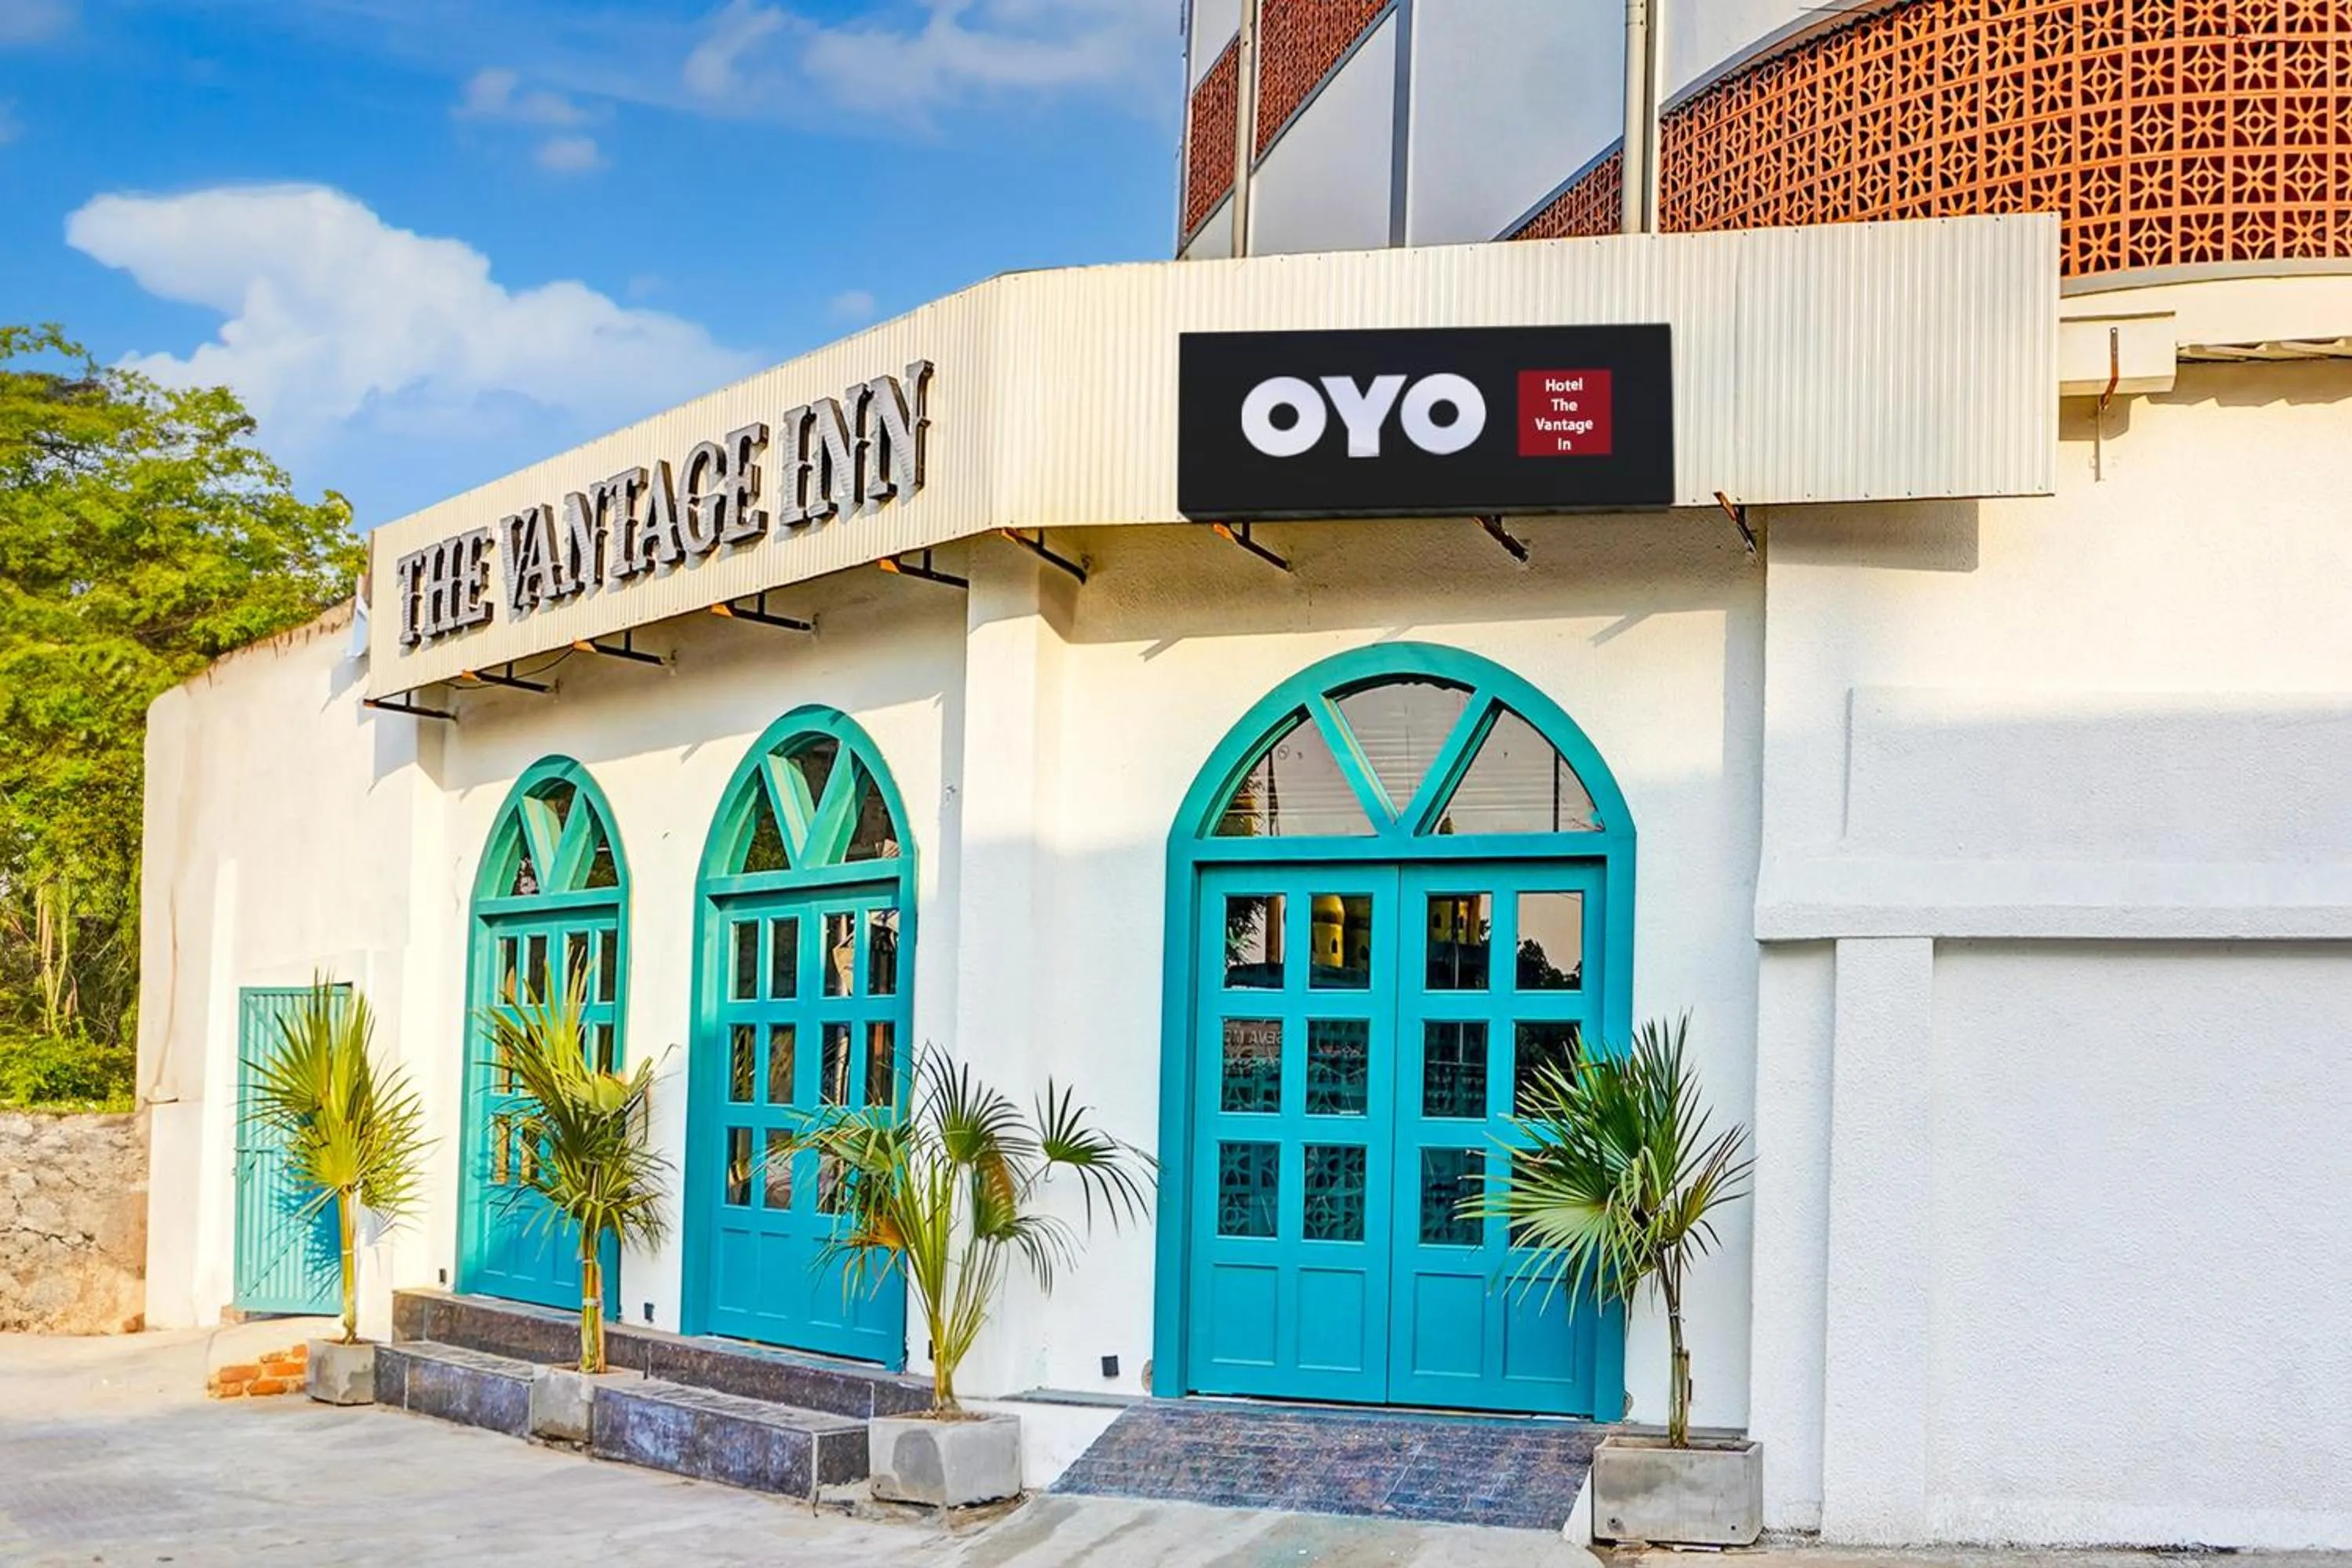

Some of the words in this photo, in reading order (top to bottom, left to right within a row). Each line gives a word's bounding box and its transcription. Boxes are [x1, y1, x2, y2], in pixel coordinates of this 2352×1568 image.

[1544, 377, 1584, 393] Hotel
[1551, 397, 1578, 412] The
[1241, 372, 1486, 458] OYO
[1534, 417, 1594, 434] Vantage
[1557, 437, 1571, 451] In
[397, 526, 495, 646] THE
[499, 422, 769, 609] VANTAGE
[779, 359, 935, 528] INN
